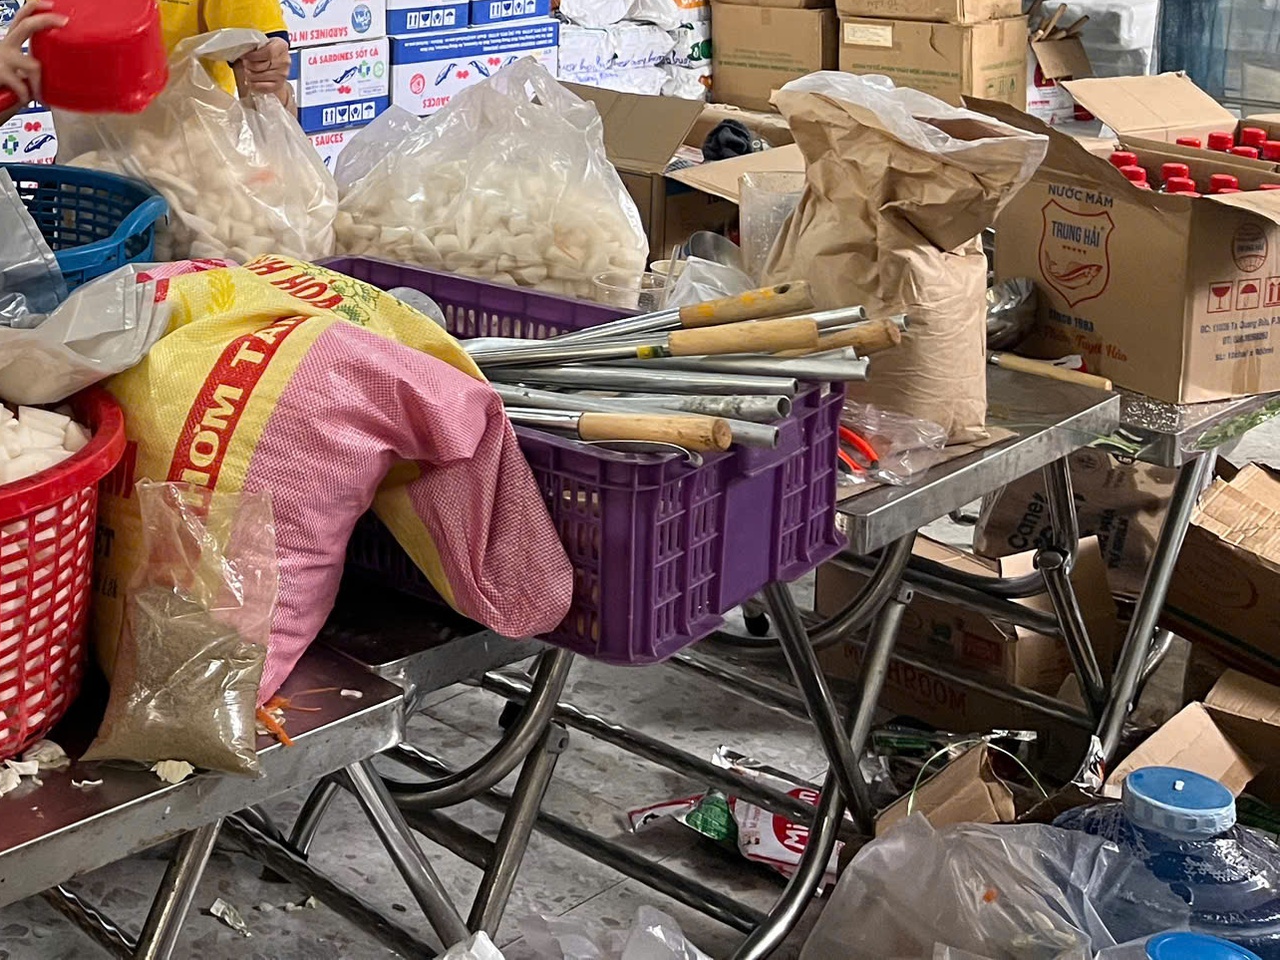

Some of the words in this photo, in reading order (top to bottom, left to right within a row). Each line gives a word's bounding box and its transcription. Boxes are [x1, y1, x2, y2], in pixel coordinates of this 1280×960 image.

[299, 31, 308, 41] IN
[310, 26, 348, 40] SARDINES
[319, 52, 353, 64] SARDINES
[315, 132, 344, 146] SAUCES
[1051, 220, 1082, 243] TRUNG
[1084, 224, 1100, 248] HẢI
